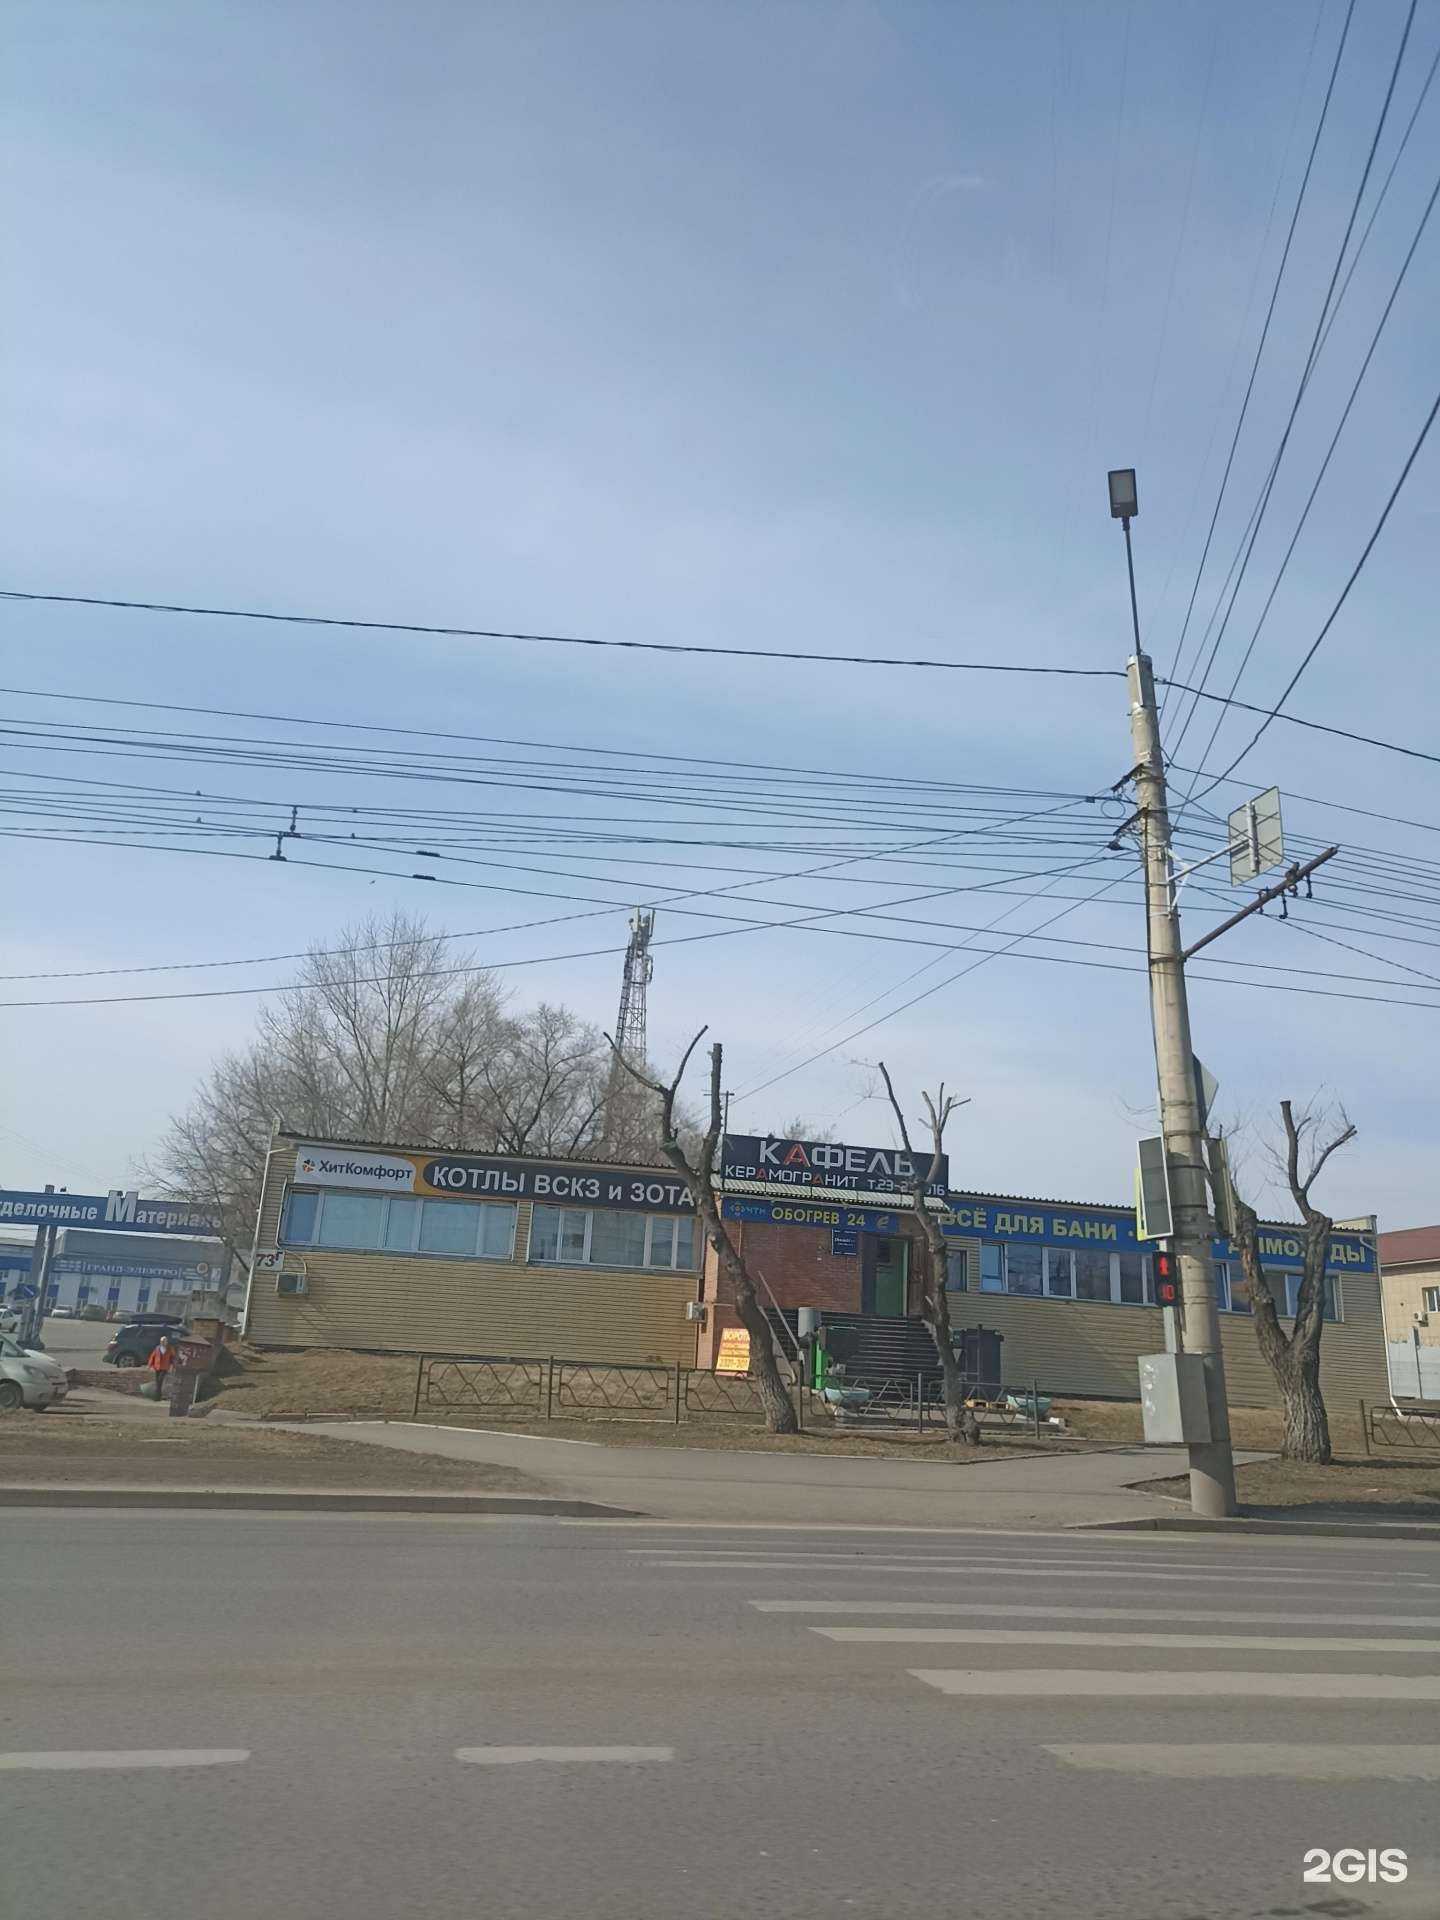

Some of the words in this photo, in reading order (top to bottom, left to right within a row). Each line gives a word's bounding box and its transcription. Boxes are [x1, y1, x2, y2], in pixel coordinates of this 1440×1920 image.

[759, 1140, 916, 1176] КАФЕЛЬ
[318, 1160, 414, 1183] ХитКомфорт
[431, 1165, 525, 1194] КОТЛЫ
[534, 1174, 600, 1199] ВСКЗ
[608, 1187, 622, 1200] и
[630, 1182, 695, 1208] ЗОТА
[725, 1165, 859, 1188] КЕРАМОГРАНИТ
[0, 1201, 98, 1220] делочные
[771, 1206, 840, 1226] ОБОГРЕВ
[847, 1212, 866, 1227] 24
[994, 1212, 1044, 1235] ДЛЯ
[1052, 1219, 1117, 1241] БАНИ
